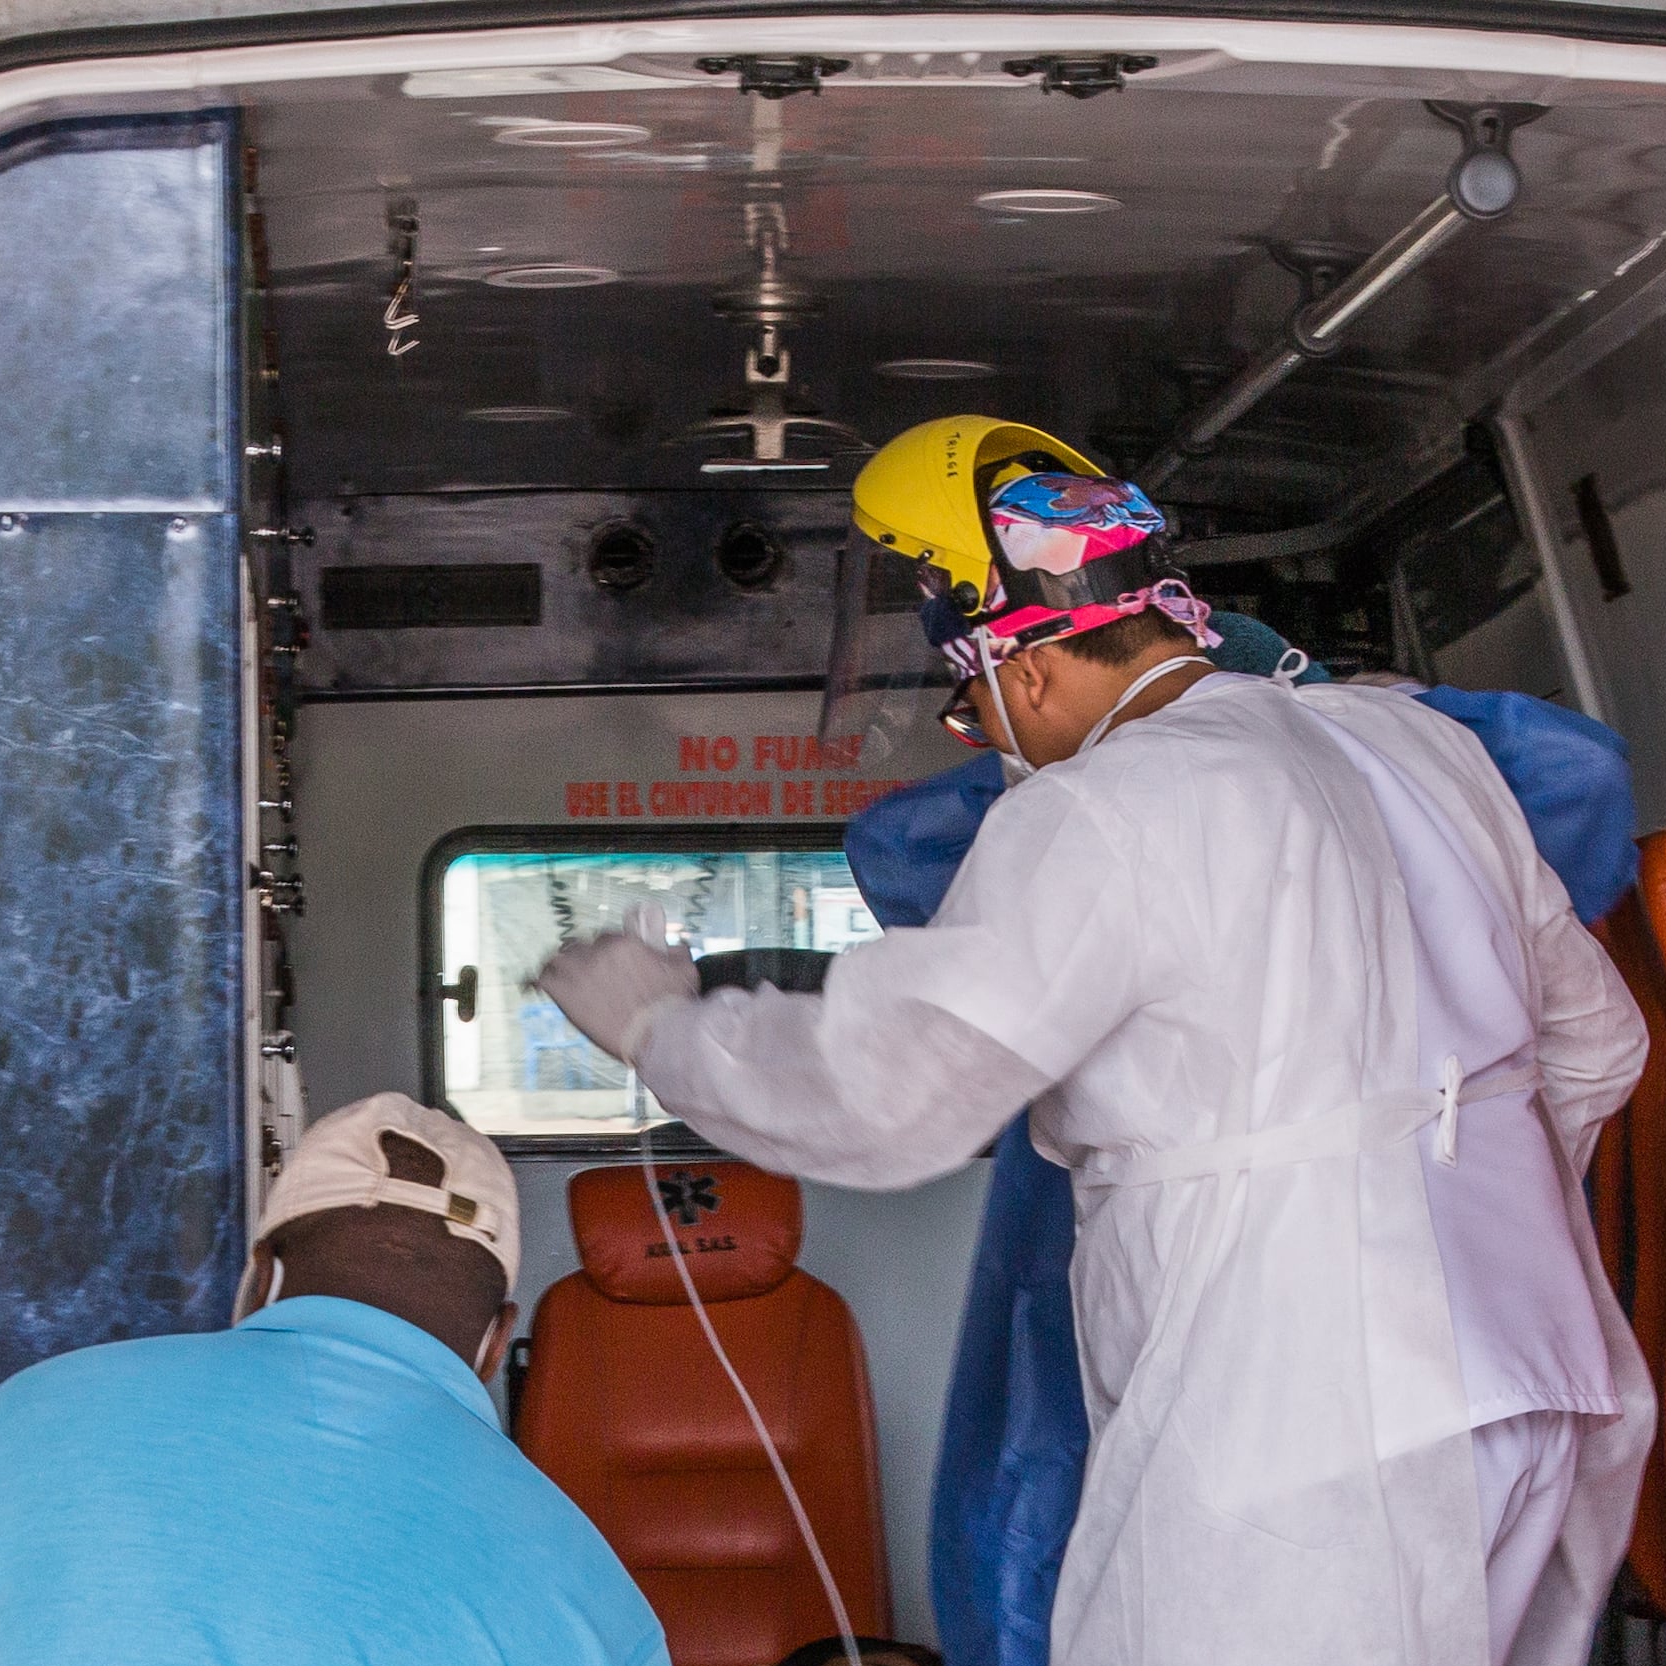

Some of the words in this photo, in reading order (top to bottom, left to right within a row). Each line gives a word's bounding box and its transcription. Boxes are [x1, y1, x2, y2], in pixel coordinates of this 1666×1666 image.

[944, 431, 961, 478] TRIAGE
[679, 736, 739, 771] NO
[782, 781, 814, 816] DE
